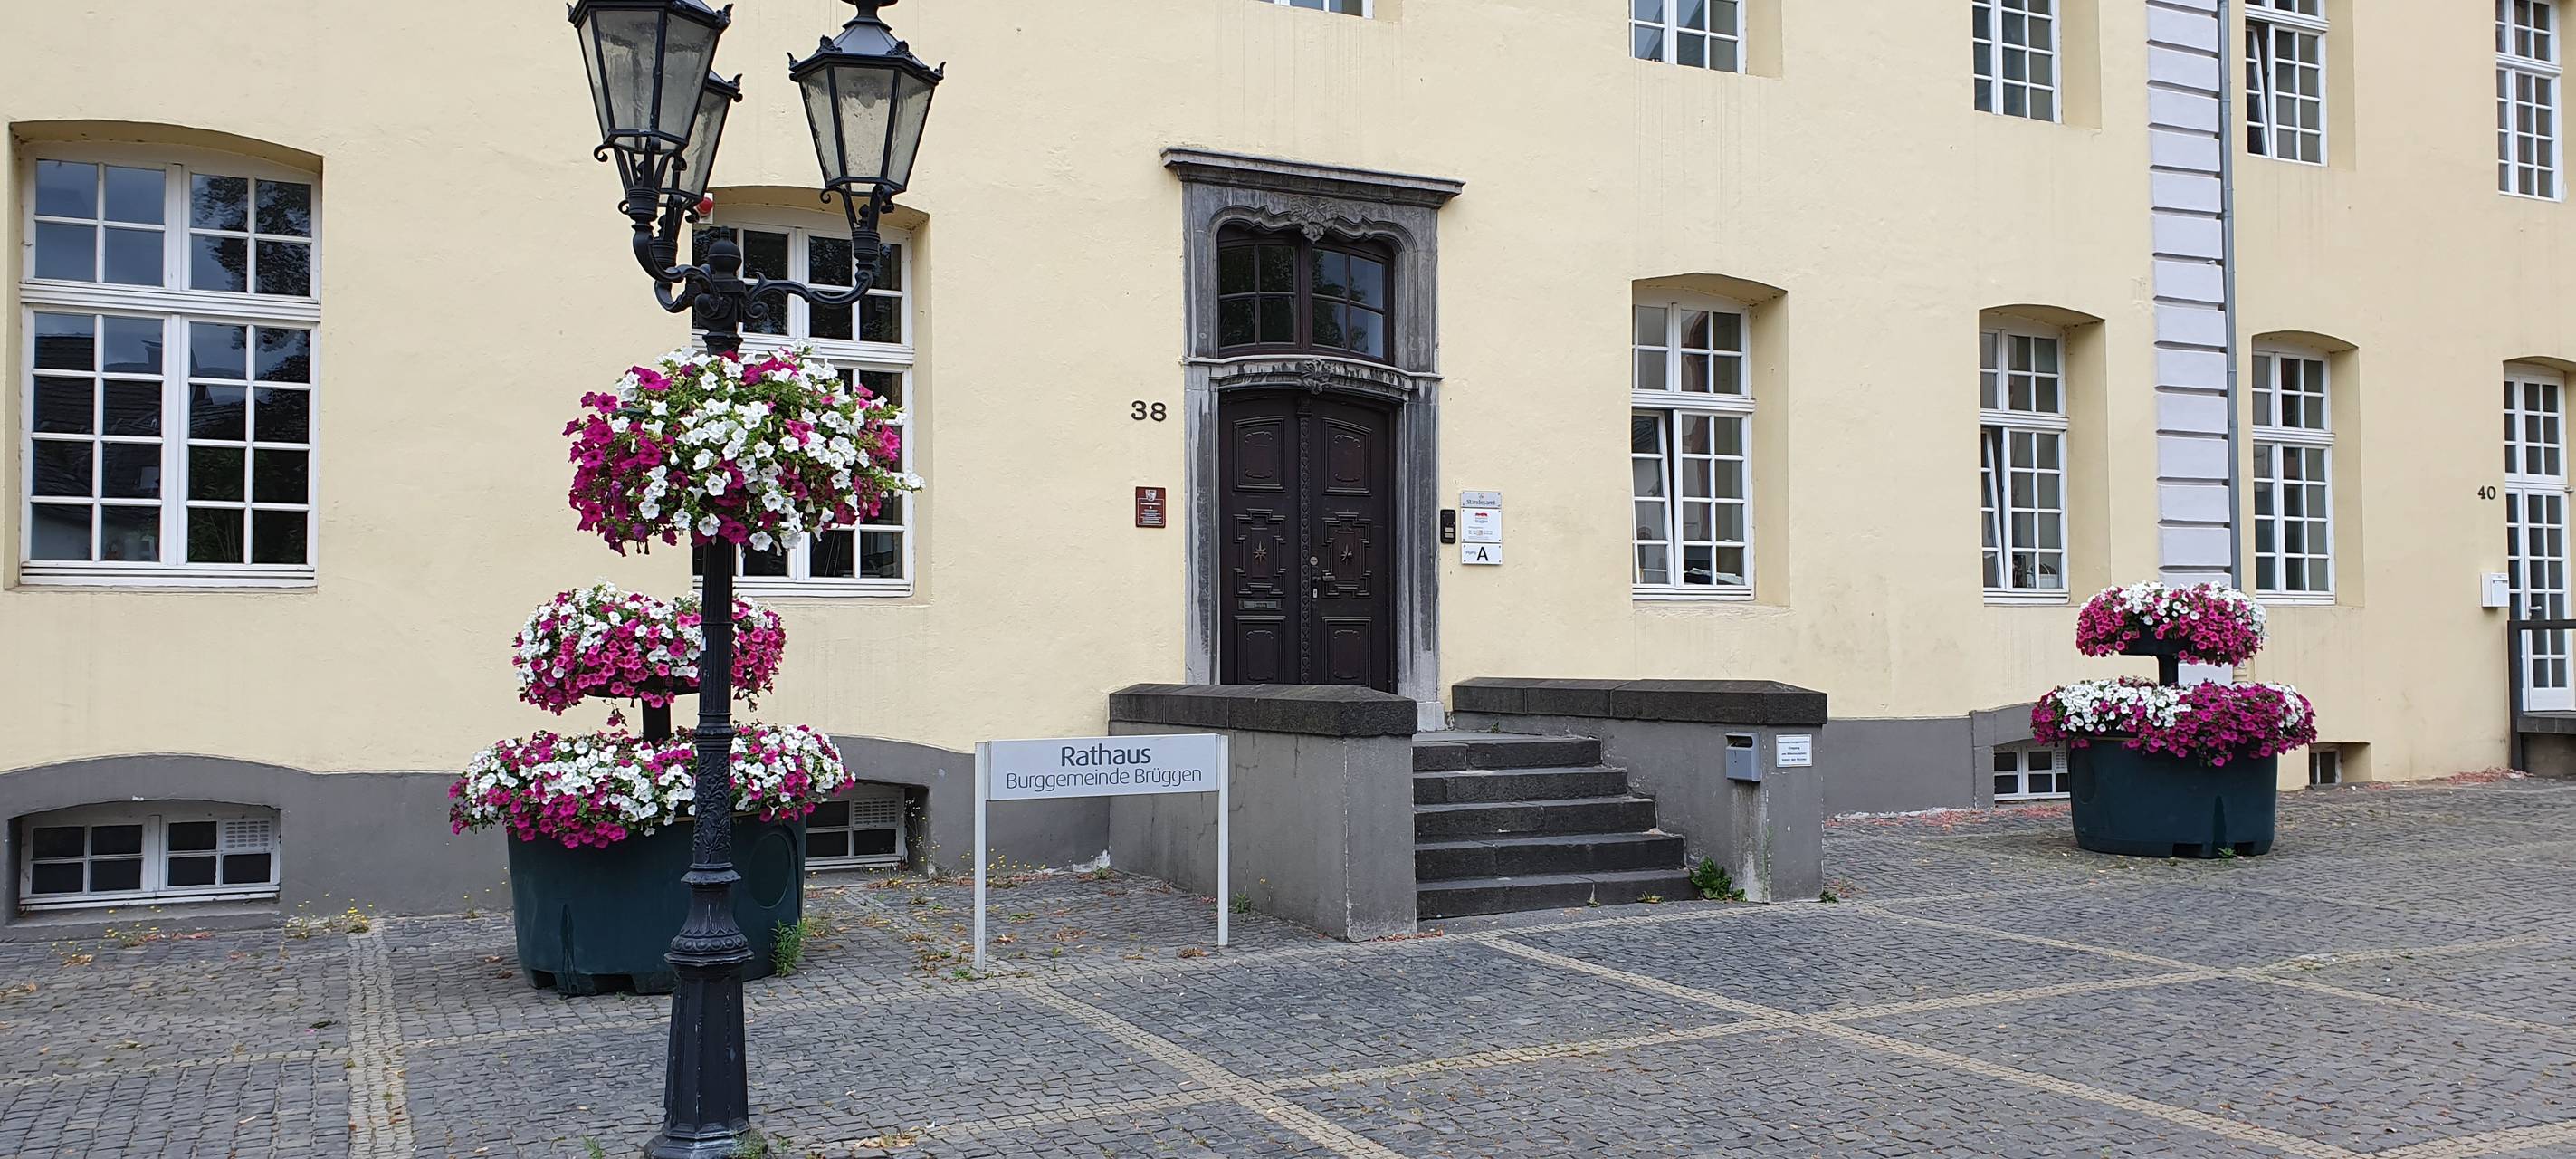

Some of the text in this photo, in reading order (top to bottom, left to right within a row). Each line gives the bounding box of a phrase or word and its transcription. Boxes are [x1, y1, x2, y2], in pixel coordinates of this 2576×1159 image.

[1131, 400, 1167, 423] 38
[2477, 485, 2496, 500] 40
[1476, 546, 1489, 561] A
[1061, 742, 1151, 767] Rathaus
[1007, 767, 1202, 792] Burggemeinde Brüggen
